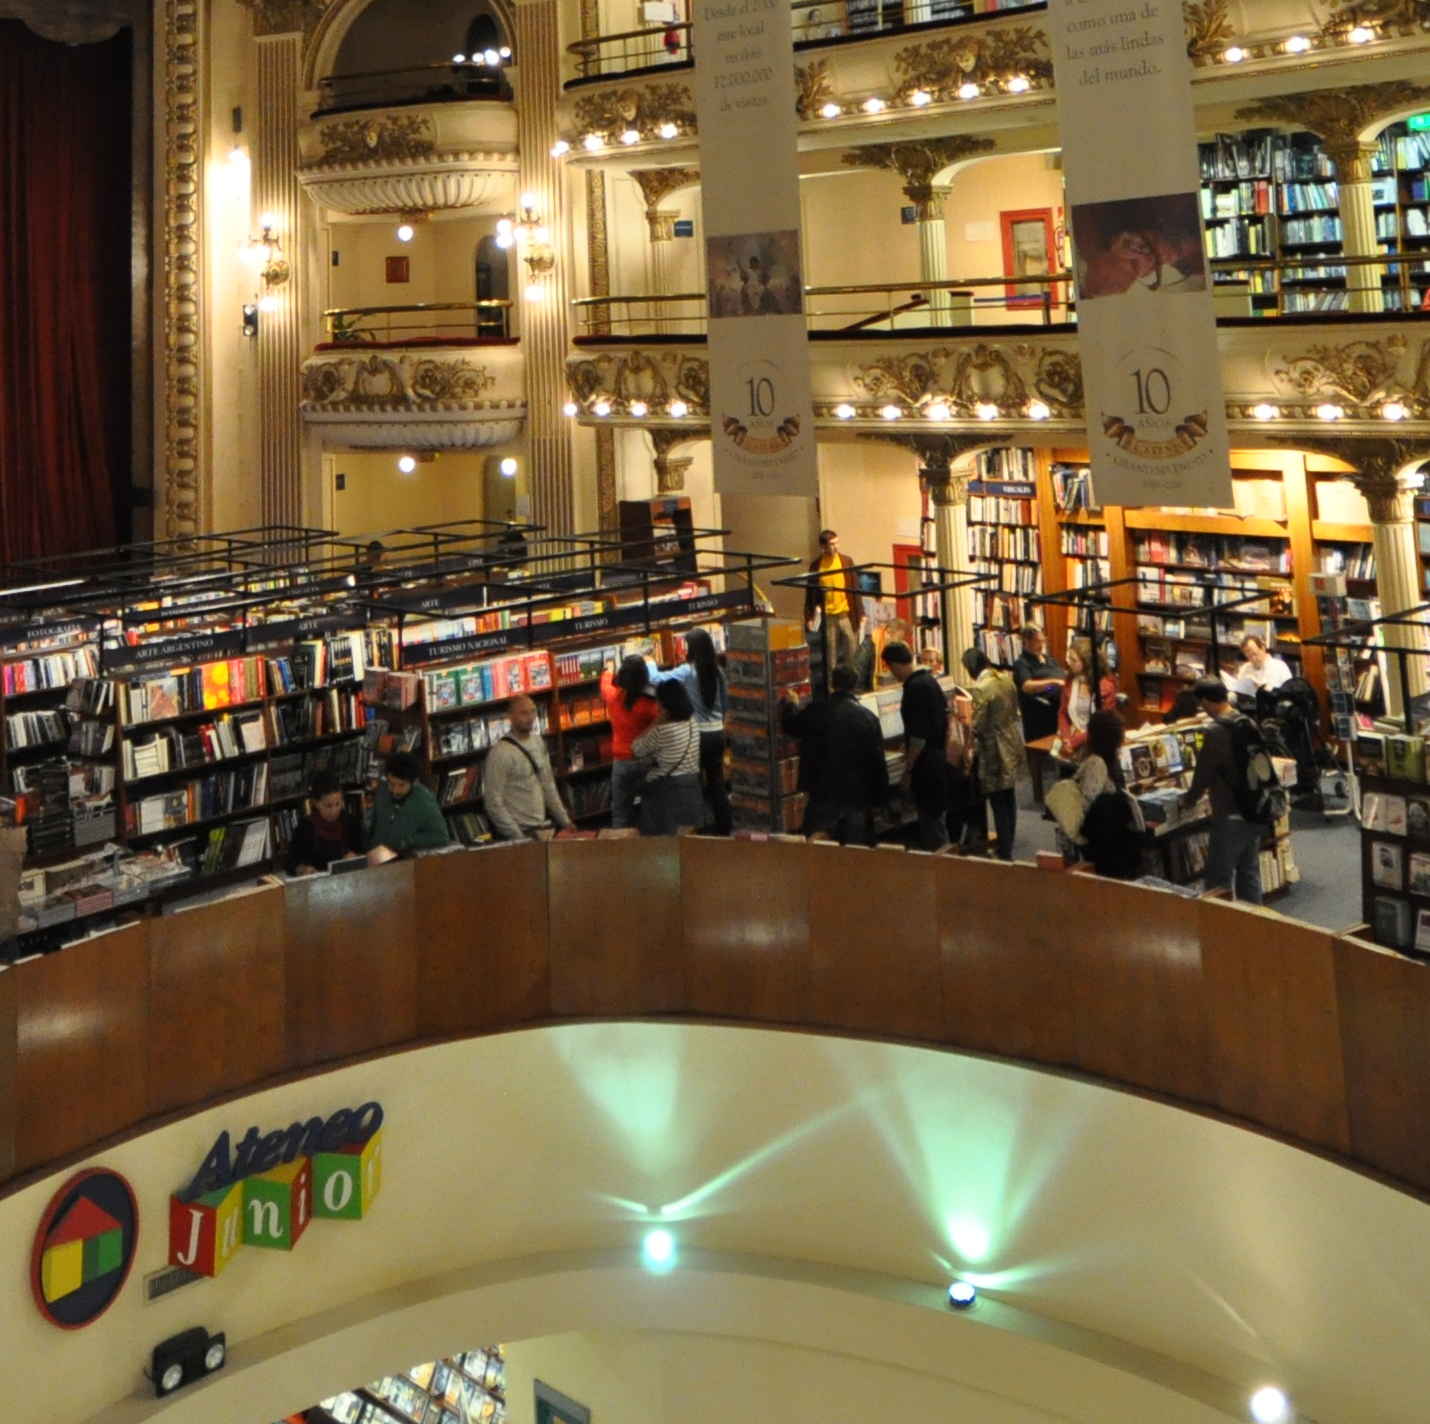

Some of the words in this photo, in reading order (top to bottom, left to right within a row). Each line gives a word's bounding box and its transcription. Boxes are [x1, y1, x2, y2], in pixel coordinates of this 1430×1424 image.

[705, 2, 736, 20] Desde
[1067, 17, 1106, 33] como
[1109, 11, 1137, 24] una
[1140, 2, 1159, 19] de
[1067, 44, 1085, 61] las
[1089, 40, 1117, 57] más
[1121, 30, 1165, 51] lindas
[1079, 67, 1101, 87] del
[745, 377, 775, 417] 10
[1131, 368, 1171, 415] 10
[420, 598, 440, 609] ARTE
[688, 598, 719, 611] TURISMO
[298, 621, 319, 632] ARTE
[575, 618, 609, 631] TURISMO
[135, 646, 159, 659] ARTE
[160, 639, 214, 655] ARGENTINO
[428, 641, 466, 657] TURISMO
[467, 636, 509, 650] NACIONAL
[179, 1101, 384, 1205] Ateneo
